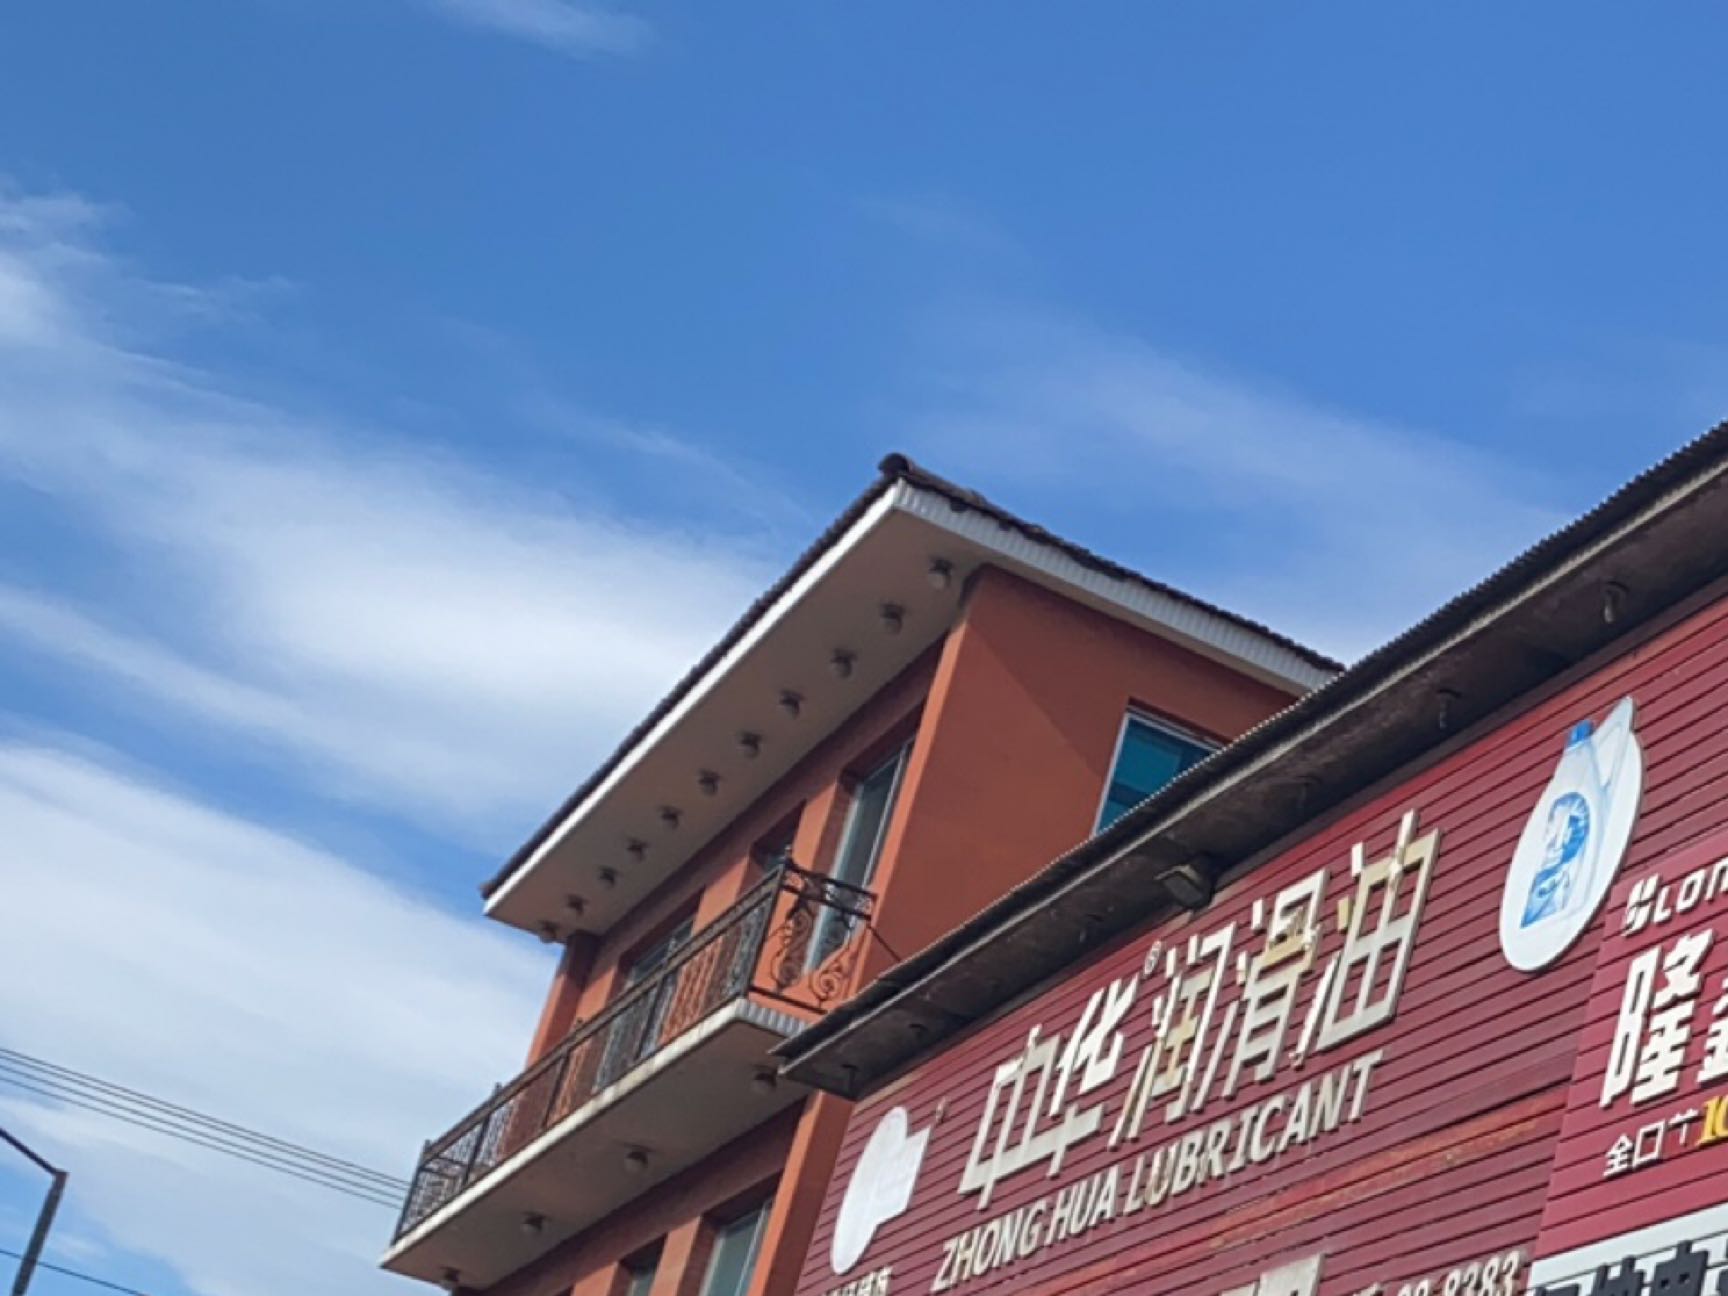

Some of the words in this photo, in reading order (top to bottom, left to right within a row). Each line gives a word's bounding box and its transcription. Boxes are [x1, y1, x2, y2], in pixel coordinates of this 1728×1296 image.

[930, 1200, 1047, 1294] ZHONG
[1043, 1163, 1123, 1243] HUA
[1122, 1048, 1386, 1217] LUBRICANT
